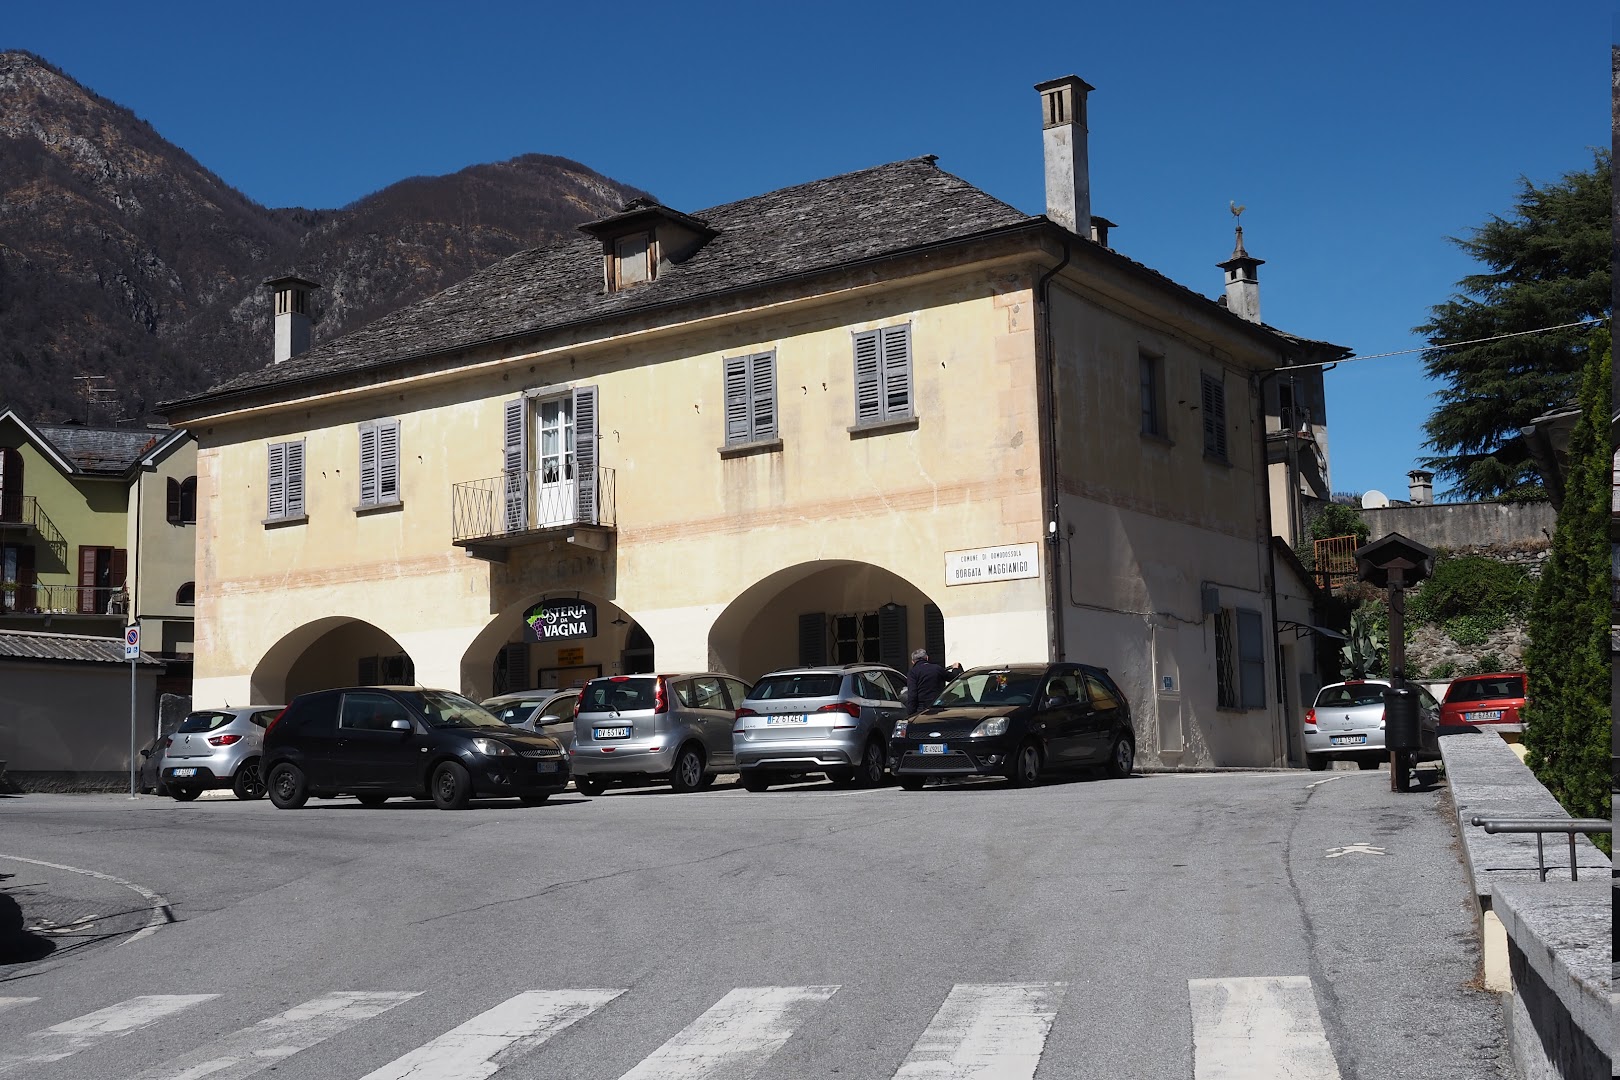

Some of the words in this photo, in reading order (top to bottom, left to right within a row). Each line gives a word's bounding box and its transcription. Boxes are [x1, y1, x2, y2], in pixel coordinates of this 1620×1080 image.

[960, 554, 978, 562] COMUNE
[991, 550, 1022, 560] DOMODOSSOLA
[955, 567, 982, 579] BORGATA
[988, 561, 1028, 575] MAGGIANIGO
[542, 605, 587, 624] OSTERIA
[543, 622, 588, 637] VAGNA
